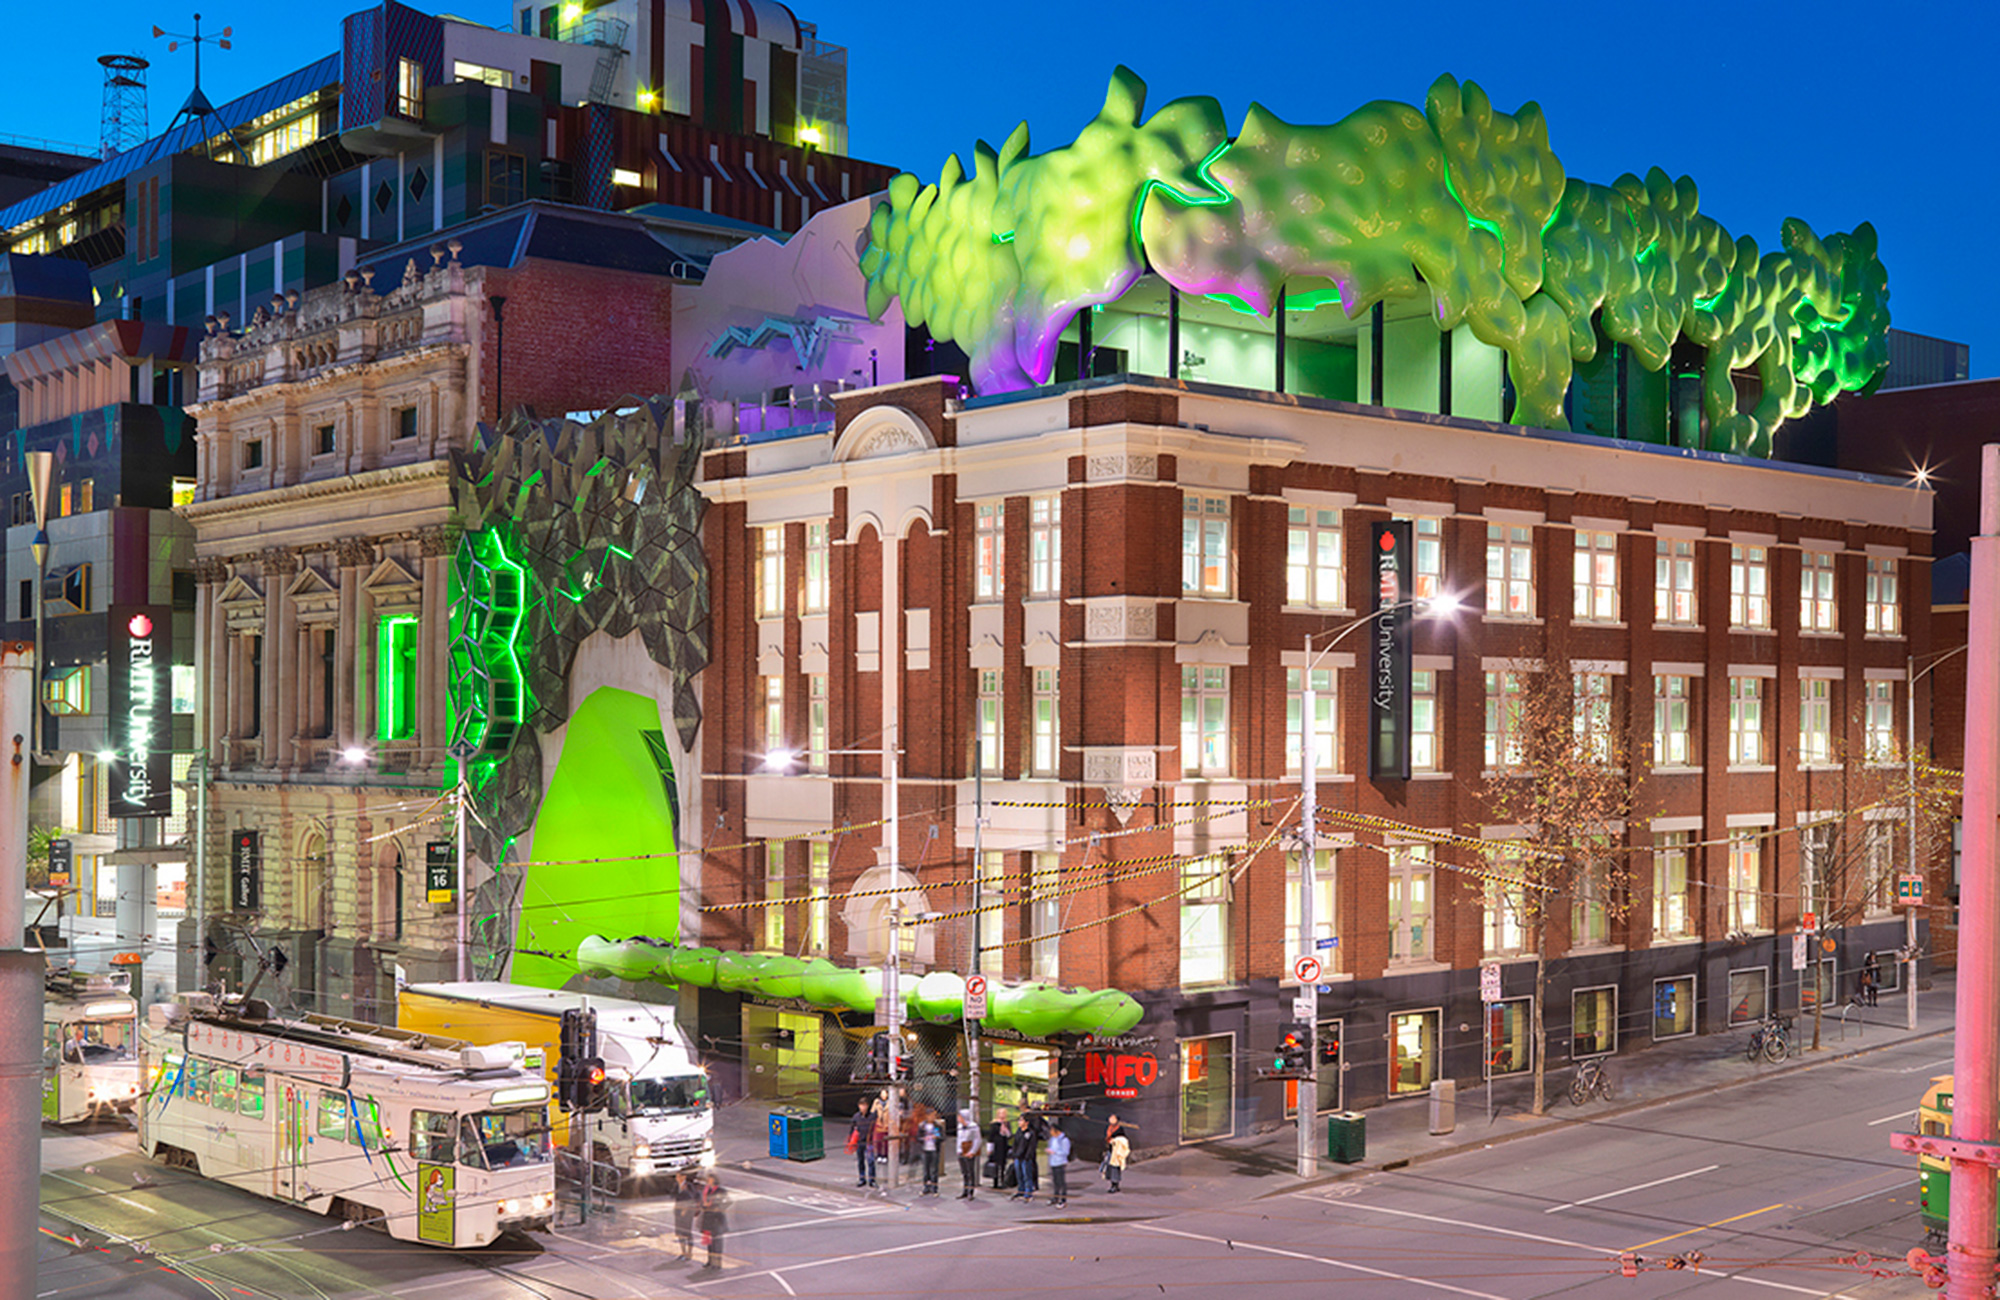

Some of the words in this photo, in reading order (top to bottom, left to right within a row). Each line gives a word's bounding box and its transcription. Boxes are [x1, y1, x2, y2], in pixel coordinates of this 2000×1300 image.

[129, 637, 153, 701] RMIT
[1373, 616, 1396, 710] University
[122, 702, 153, 806] University
[432, 873, 448, 888] 16
[970, 996, 983, 1004] NO
[1085, 1051, 1158, 1088] INFO
[1106, 1089, 1136, 1097] CORNER
